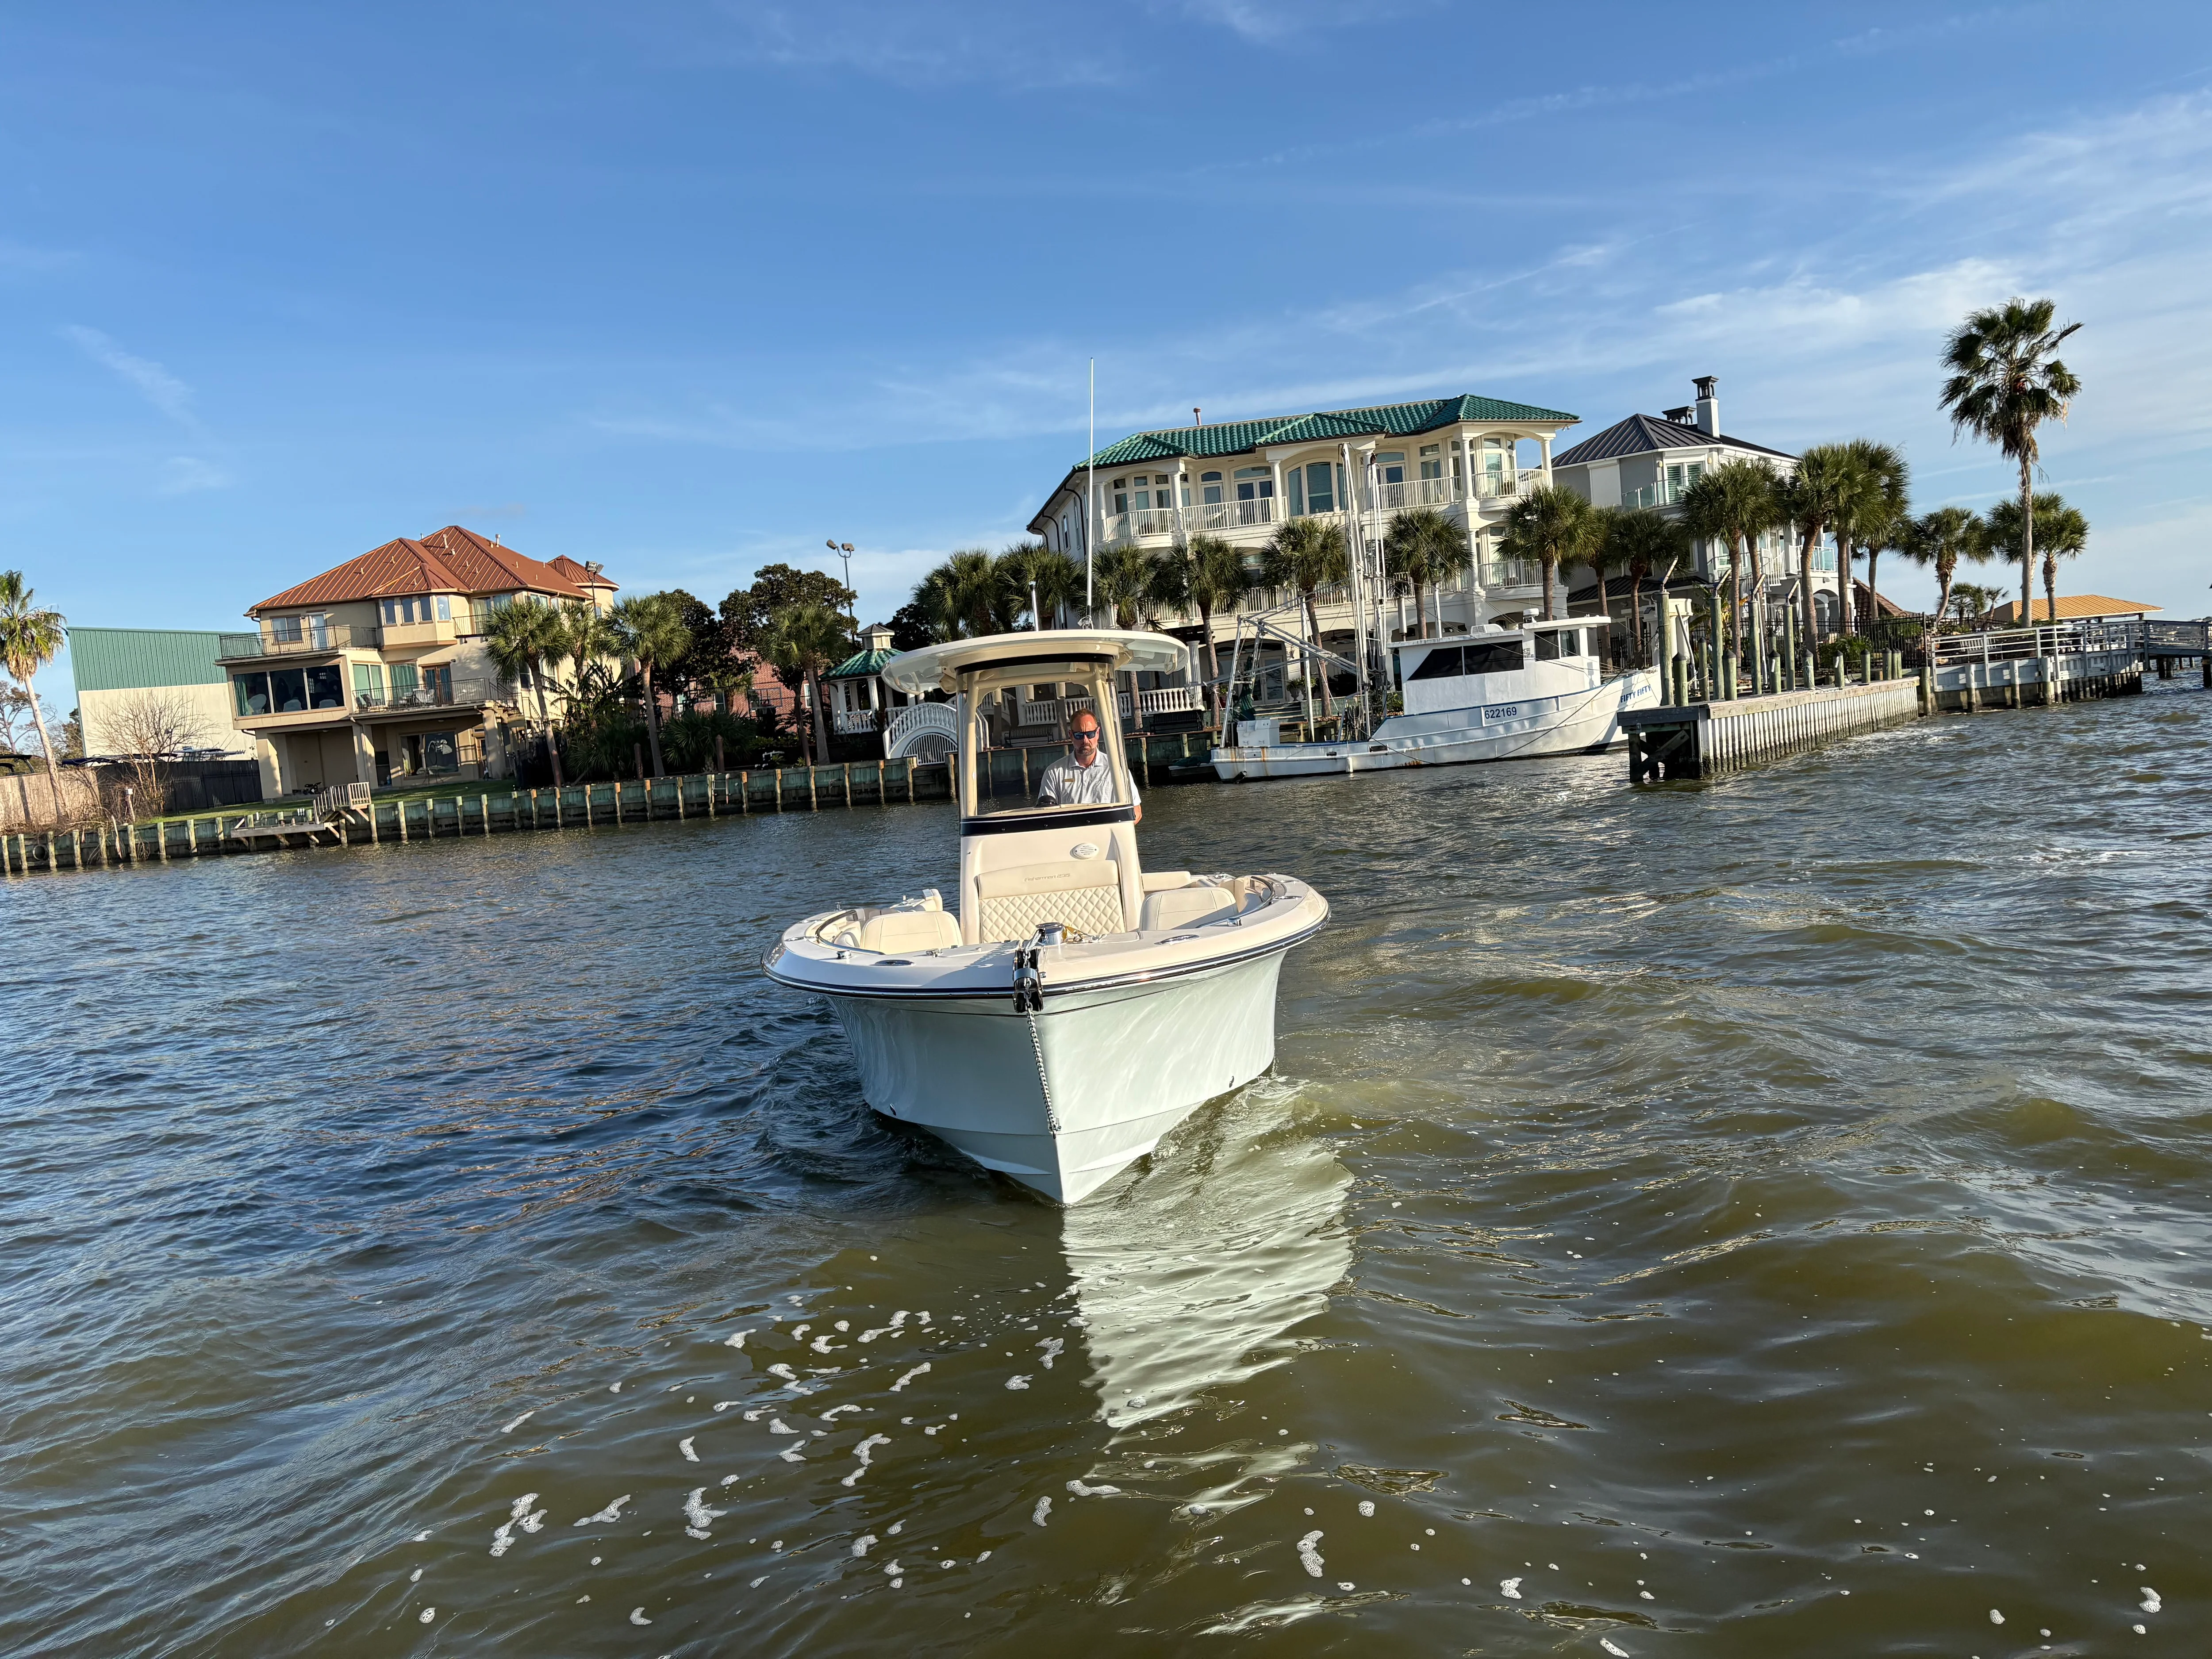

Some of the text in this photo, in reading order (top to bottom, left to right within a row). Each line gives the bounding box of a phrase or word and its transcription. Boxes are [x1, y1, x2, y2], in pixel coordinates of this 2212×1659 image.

[1620, 685, 1651, 703] FIFTY FIFTY
[1485, 707, 1517, 719] 622169
